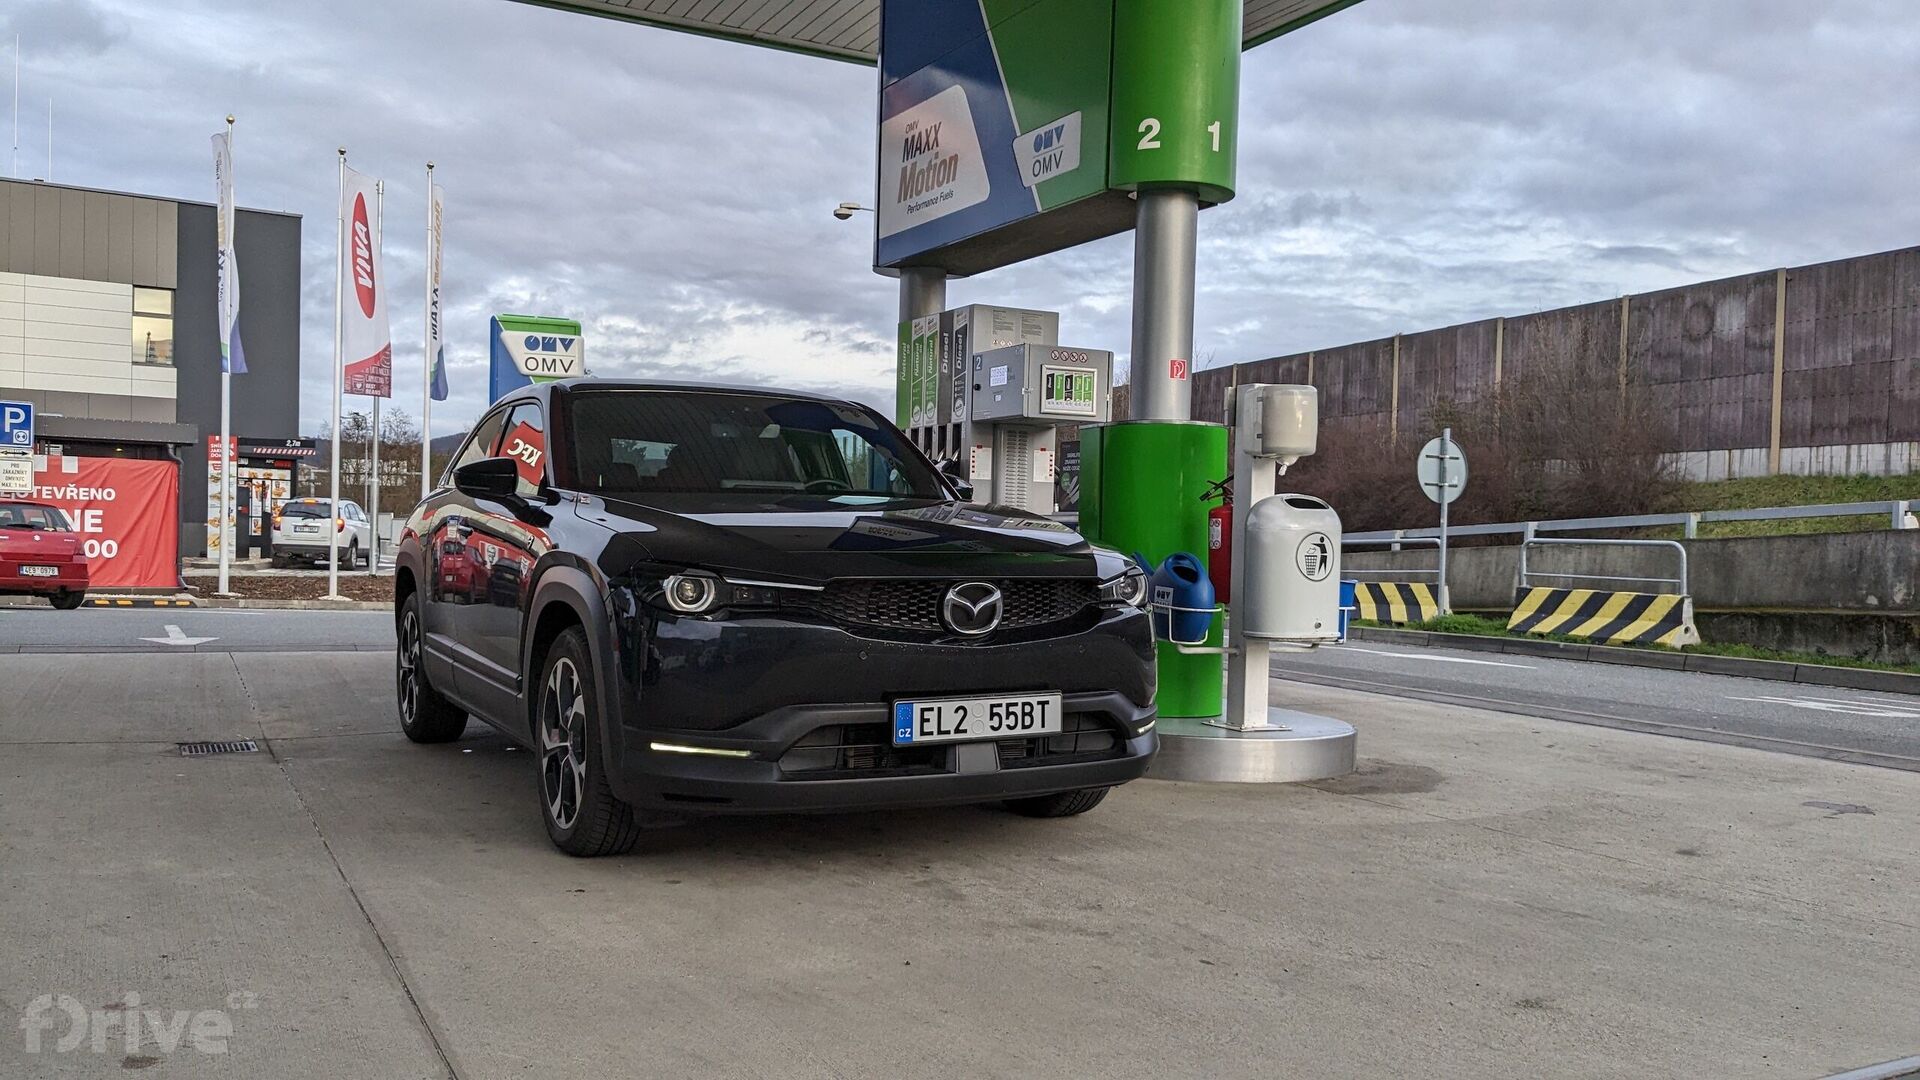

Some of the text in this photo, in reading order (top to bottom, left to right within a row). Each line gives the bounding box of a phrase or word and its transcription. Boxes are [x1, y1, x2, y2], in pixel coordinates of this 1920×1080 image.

[905, 119, 919, 134] OMV
[1033, 124, 1065, 153] OMV
[1137, 117, 1161, 151] 2
[1207, 120, 1221, 153] 1
[902, 121, 942, 163] MAXX
[897, 151, 959, 204] Motion
[1032, 150, 1063, 178] OMV
[906, 188, 954, 215] Performance Fuels
[354, 220, 374, 289] VIVA
[524, 335, 576, 352] OMV
[524, 357, 574, 374] OMV
[976, 356, 982, 370] 2
[4, 406, 26, 433] P
[919, 700, 1050, 737] EL2 55BT
[898, 728, 911, 738] CZ
